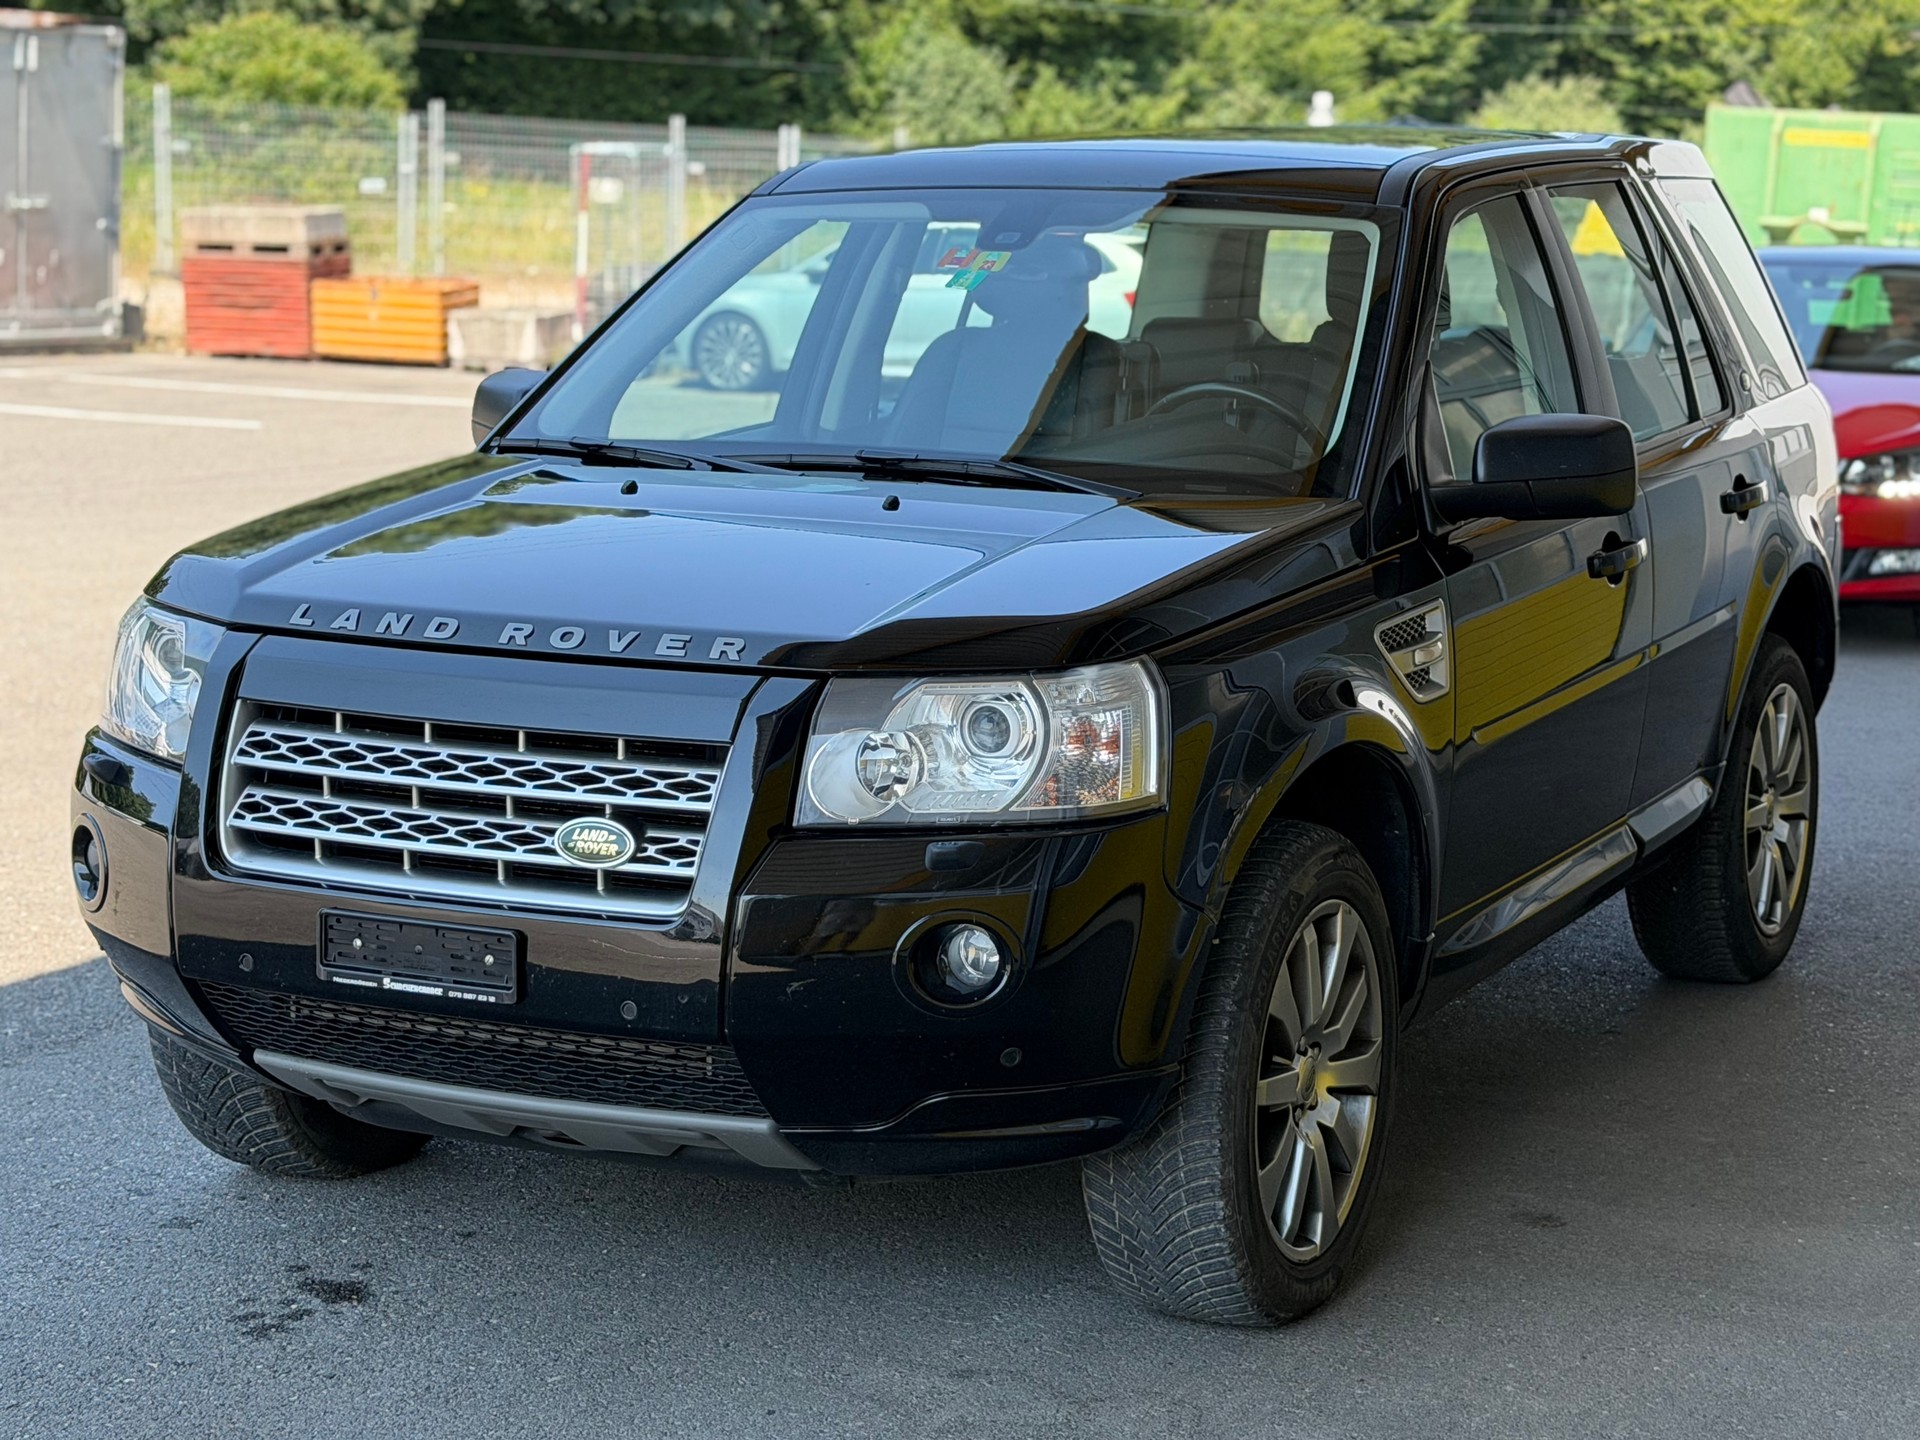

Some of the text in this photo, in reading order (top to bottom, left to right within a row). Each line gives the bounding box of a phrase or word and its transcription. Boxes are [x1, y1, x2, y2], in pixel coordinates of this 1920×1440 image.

[289, 603, 746, 661] LAND ROVER
[572, 827, 609, 842] LAND
[574, 841, 619, 856] ROVER
